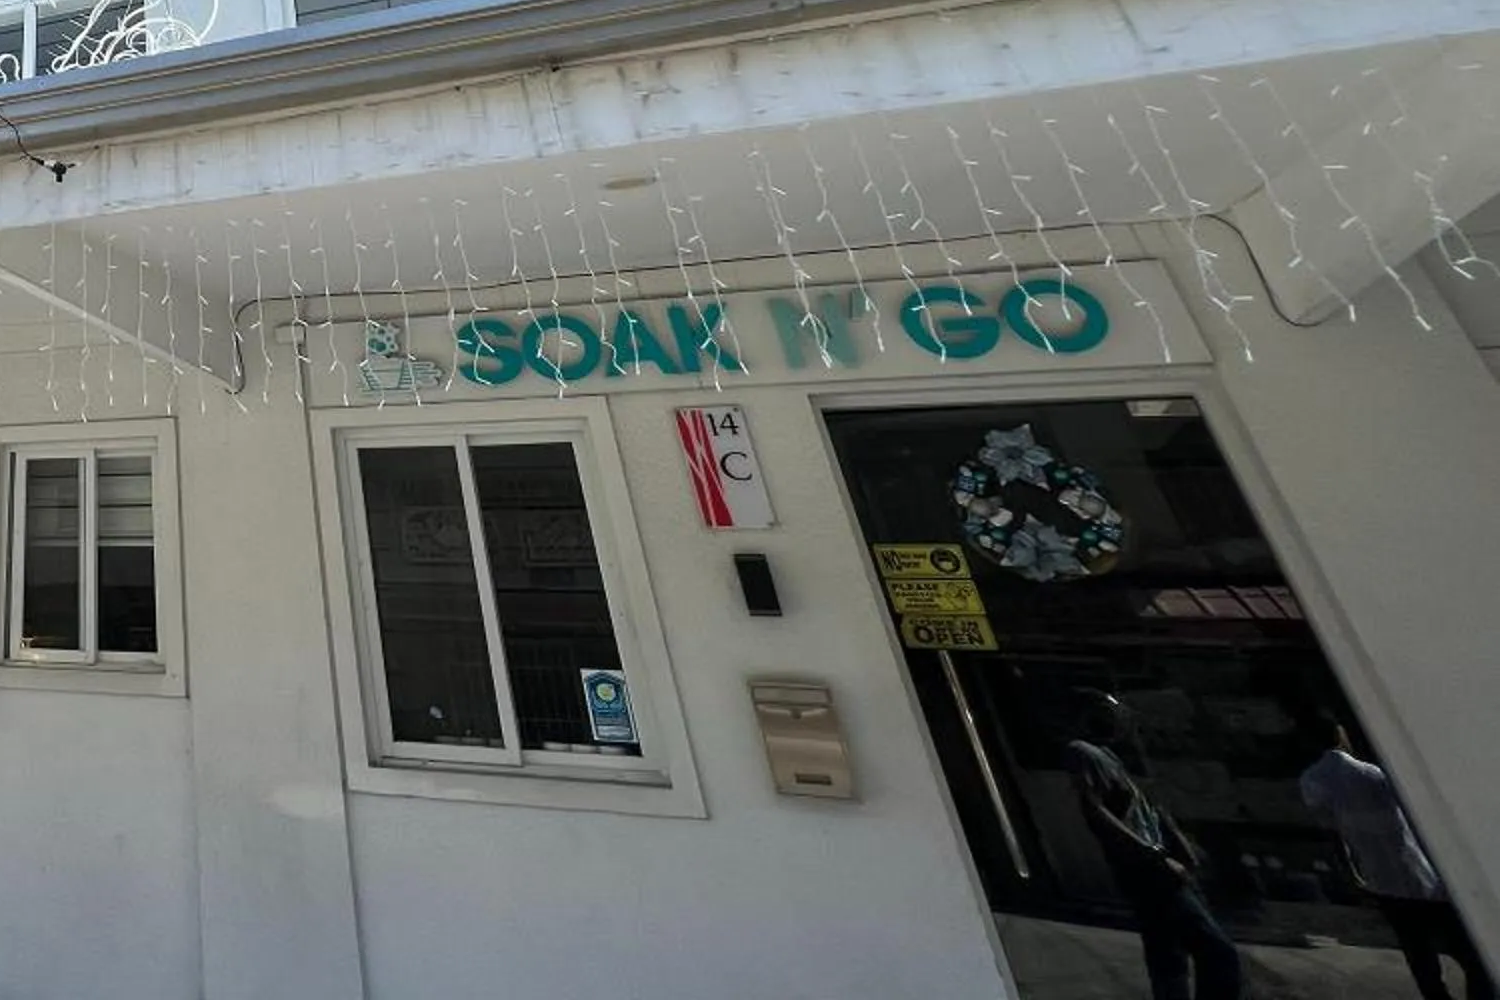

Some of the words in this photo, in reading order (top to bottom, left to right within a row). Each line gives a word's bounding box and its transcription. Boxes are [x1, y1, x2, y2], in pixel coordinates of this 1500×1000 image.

[455, 300, 748, 386] SOAK
[899, 278, 1109, 360] GO
[707, 411, 740, 437] 14
[720, 451, 753, 481] C
[913, 625, 986, 646] OPEN
